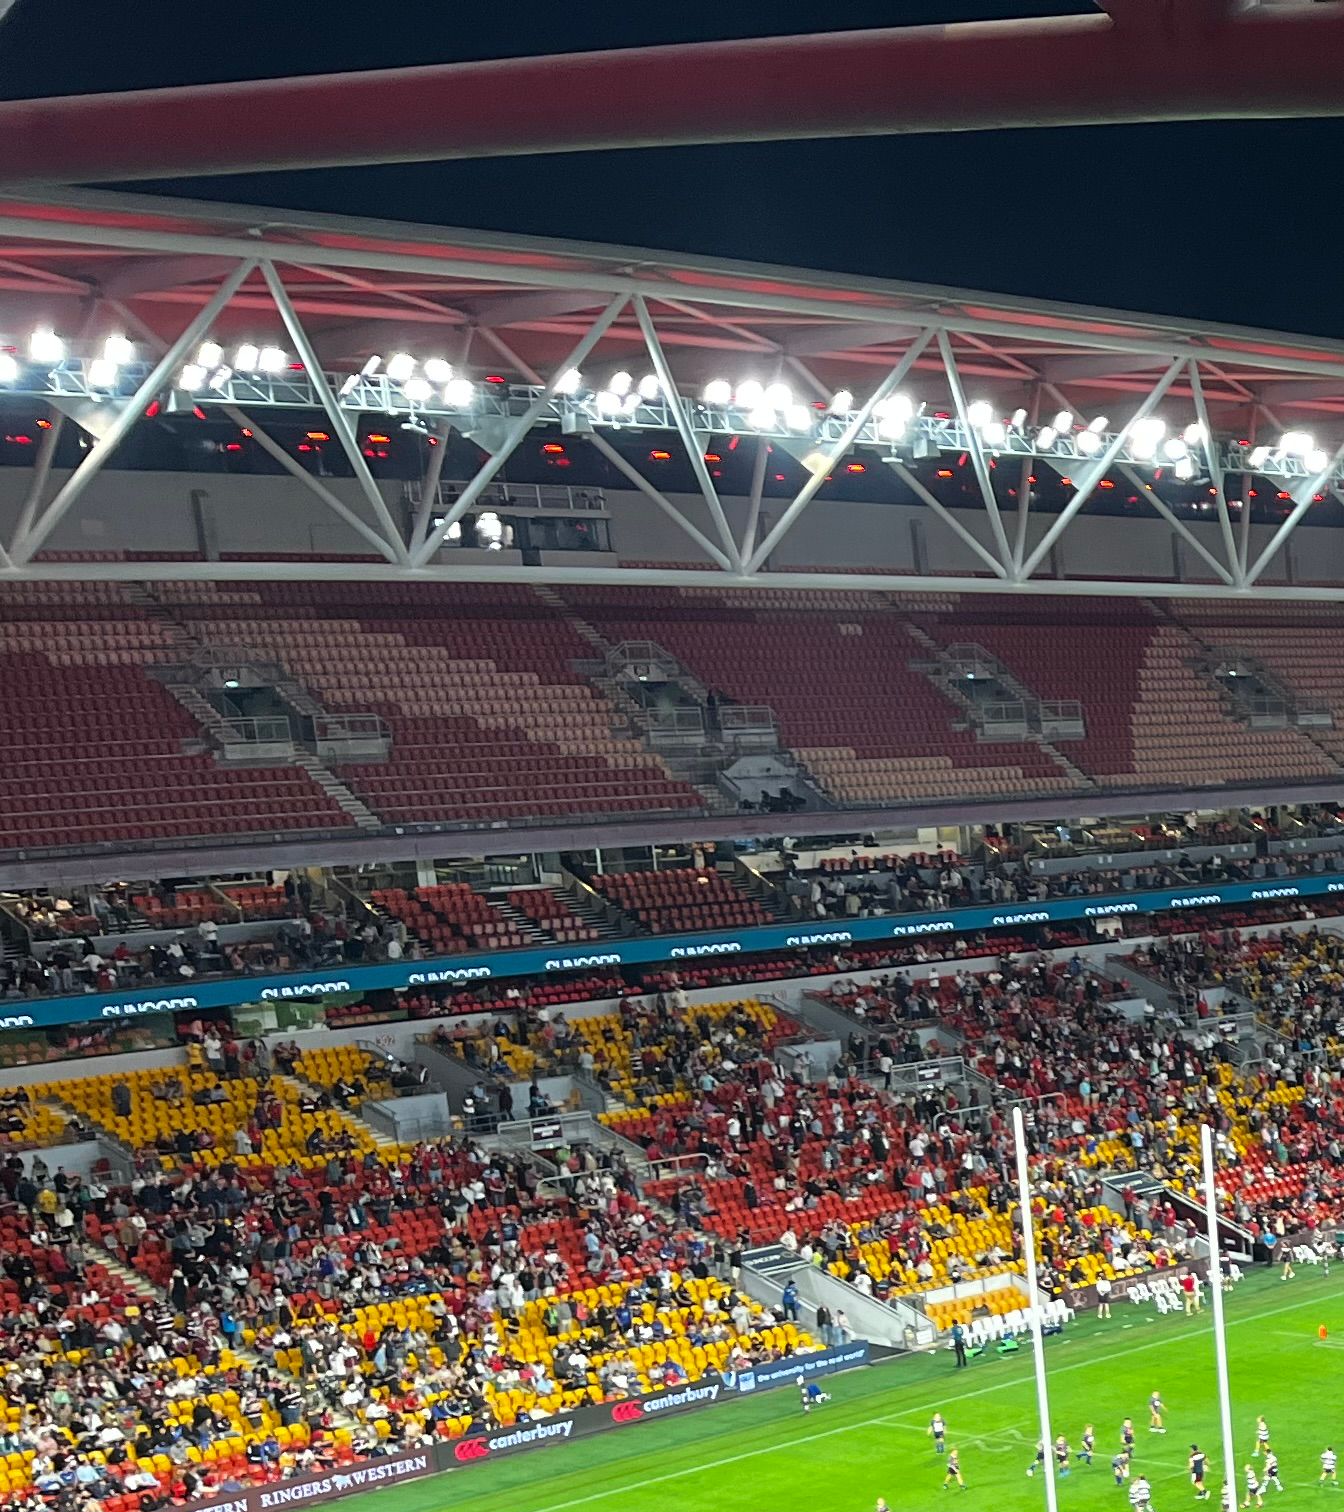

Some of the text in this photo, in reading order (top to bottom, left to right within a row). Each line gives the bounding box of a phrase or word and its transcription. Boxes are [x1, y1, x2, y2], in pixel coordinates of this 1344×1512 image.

[643, 1384, 719, 1413] canterbury
[489, 1420, 573, 1450] canterbury
[261, 1456, 427, 1508] RINGERS WESTERN
